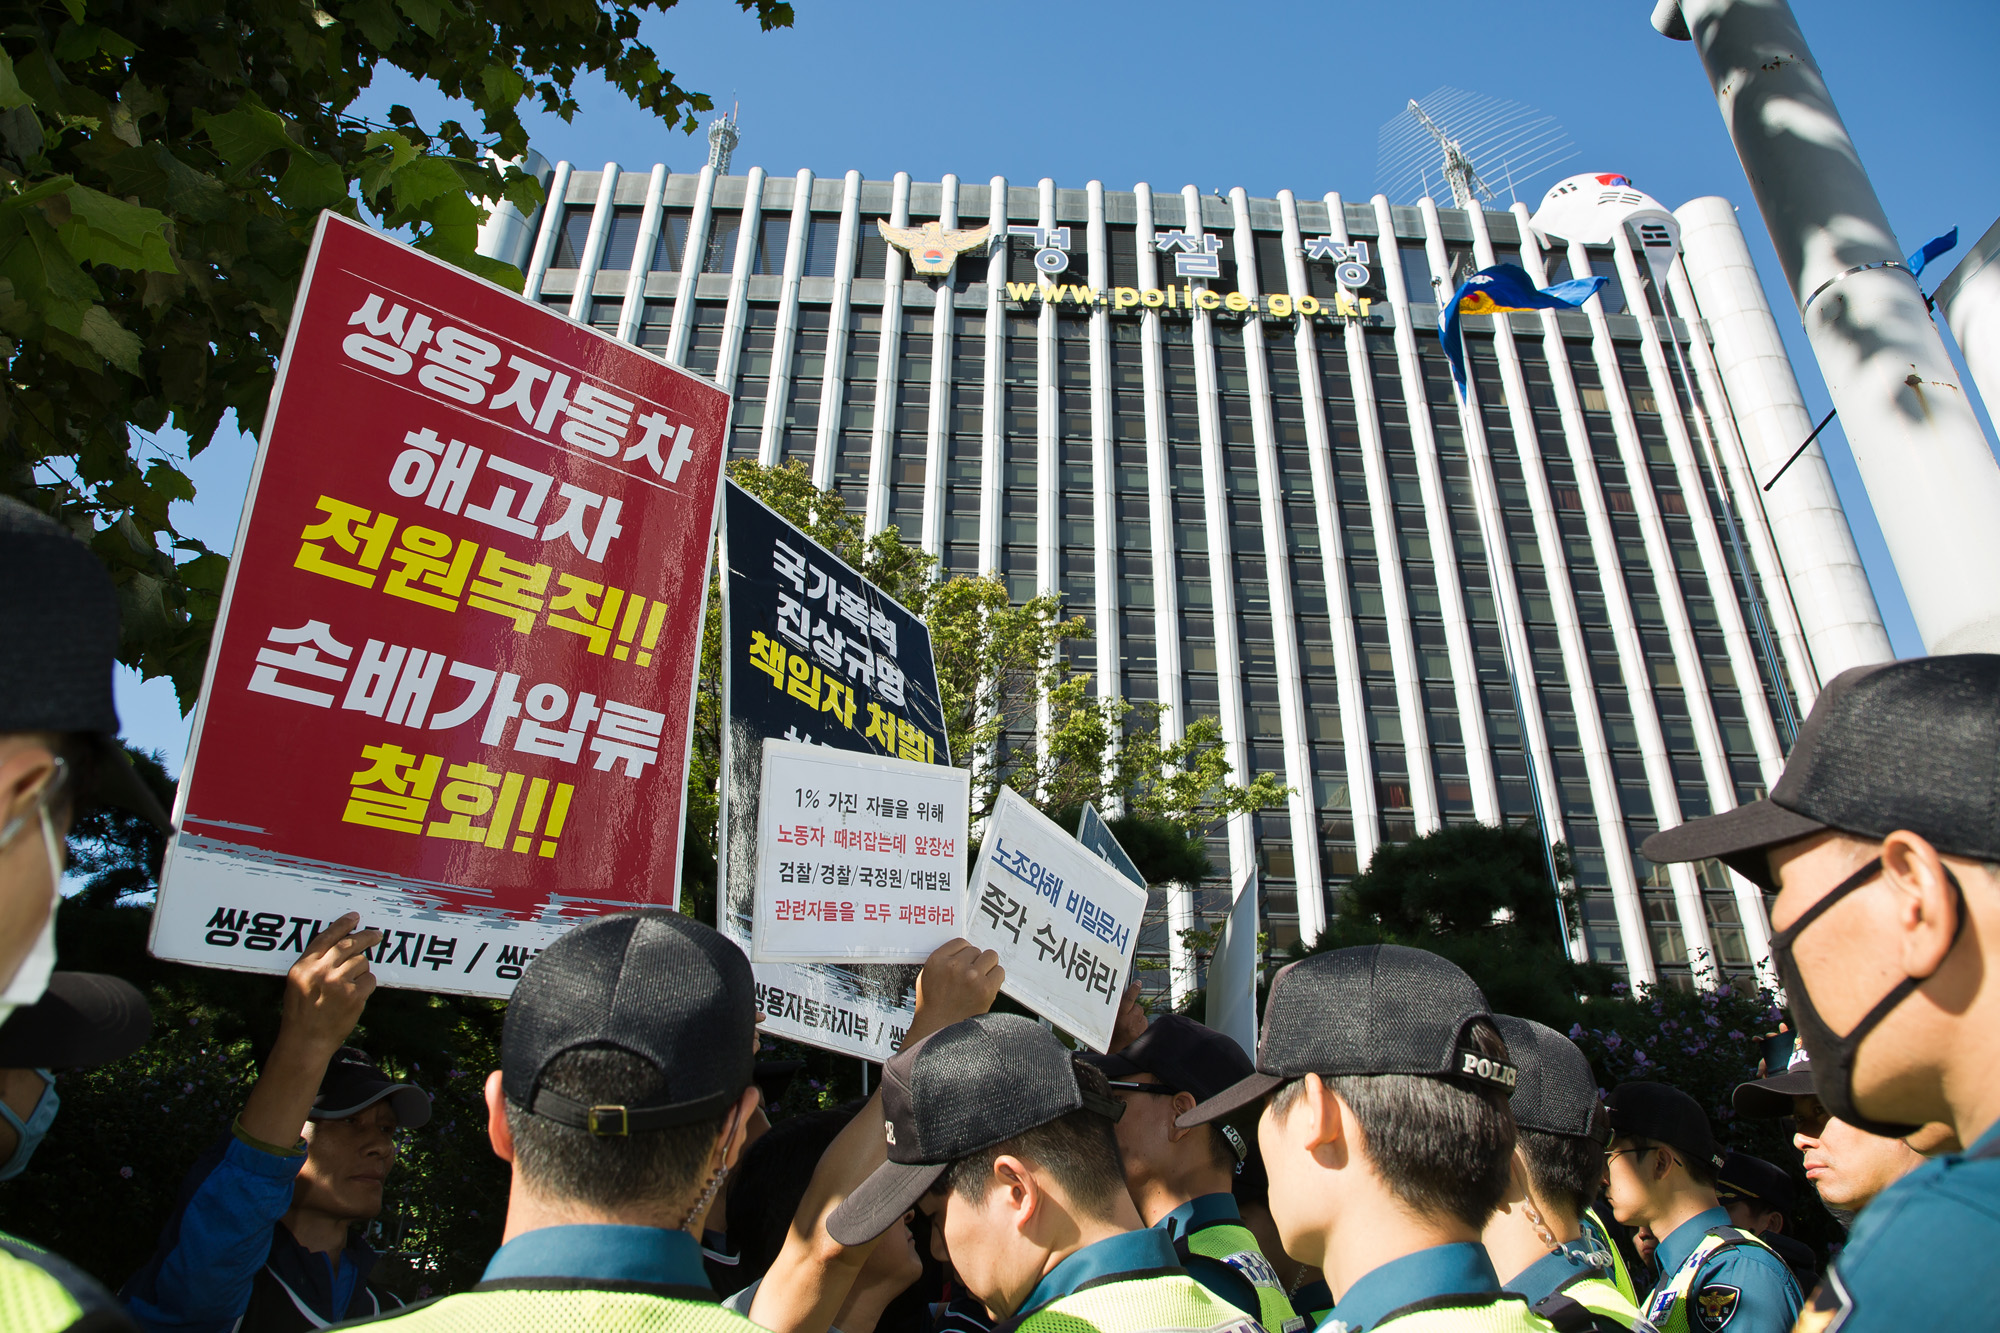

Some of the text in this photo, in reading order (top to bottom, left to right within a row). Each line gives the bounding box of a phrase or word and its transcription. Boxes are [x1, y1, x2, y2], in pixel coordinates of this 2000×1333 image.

[1005, 281, 1372, 318] www.police.go.kr
[342, 293, 694, 483] 쌍용자동차
[388, 428, 623, 563] 해고자
[293, 494, 668, 667] 전원복직!!
[773, 539, 897, 658] 국가폭력
[246, 619, 666, 779] 손배가압류
[750, 630, 857, 730] 책임자
[777, 592, 905, 706] 진상규명
[341, 742, 575, 858] 철회!!
[777, 824, 955, 858] 노동자 때려잡는데 앞장선
[795, 788, 944, 823] 1% 가진 자들을 위해
[775, 899, 955, 926] 관련자들을 모두 파면하라
[778, 861, 951, 891] 검찰/경찰/국정원/대법원
[990, 837, 1064, 908] 노조와해
[1066, 888, 1130, 955] 비밀문서
[205, 907, 458, 972] 쌍용자차지부
[495, 944, 544, 980] 쌍
[980, 881, 1118, 1006] 즉각 수사하라
[1462, 1053, 1517, 1087] POLIC
